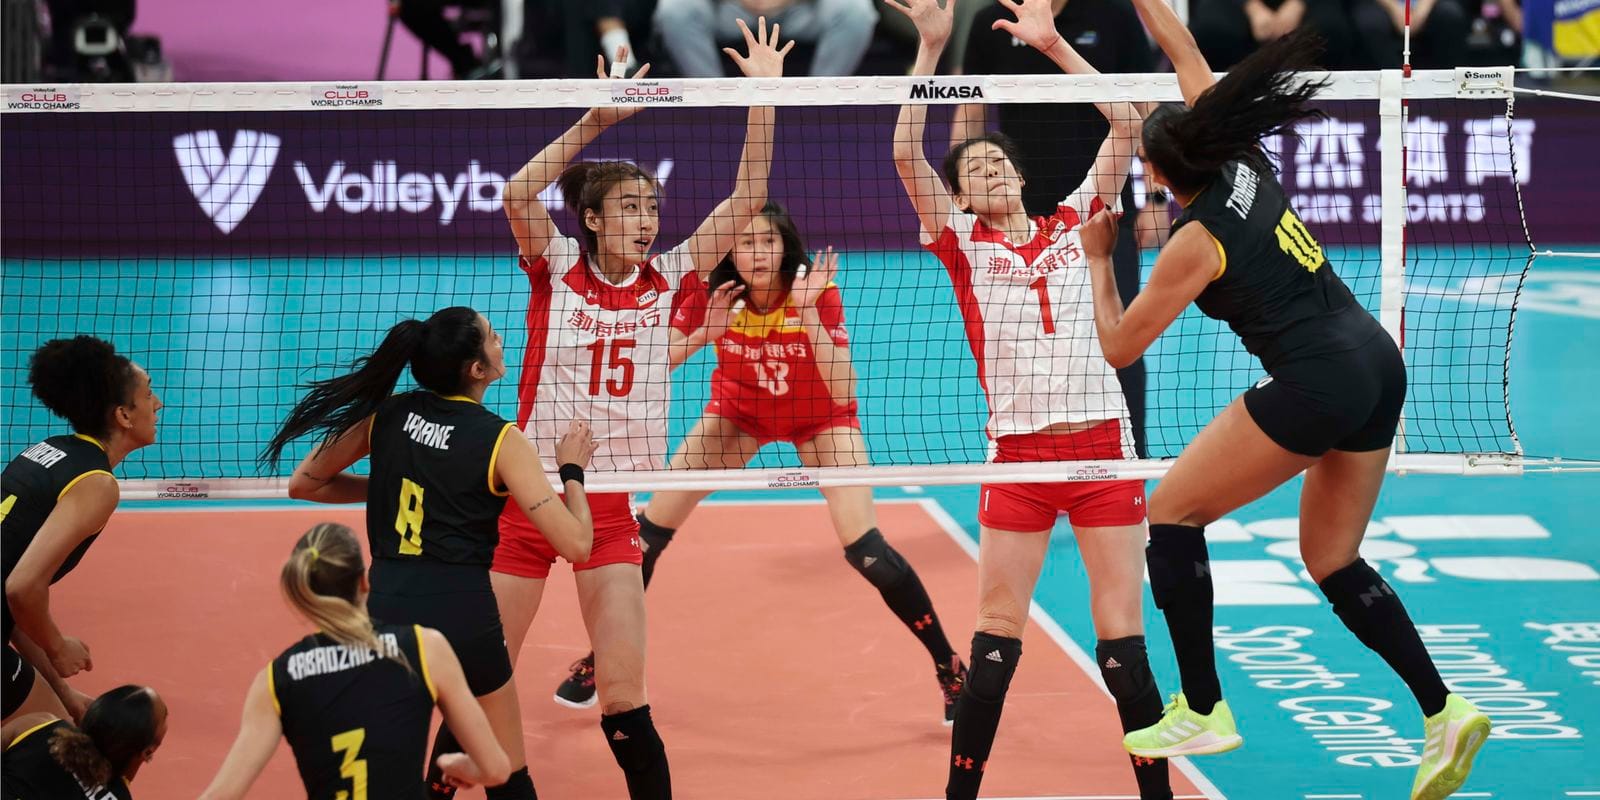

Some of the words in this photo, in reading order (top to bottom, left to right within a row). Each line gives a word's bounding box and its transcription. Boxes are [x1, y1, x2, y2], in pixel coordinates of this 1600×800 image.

[21, 93, 67, 102] CLUB
[324, 91, 369, 99] CLUB
[625, 87, 670, 96] CLUB
[646, 95, 683, 103] CHAMPS
[293, 159, 565, 225] Volleybl
[1290, 194, 1351, 223] GER
[1362, 193, 1486, 223] SORTS
[1274, 208, 1325, 273] 10
[638, 292, 657, 303] CHN
[1029, 276, 1056, 334] 1
[586, 338, 636, 398] 15
[745, 358, 790, 396] 13
[984, 489, 990, 512] 1
[1213, 625, 1361, 690] Sports
[1278, 695, 1426, 768] Centre
[331, 728, 368, 800] 3
